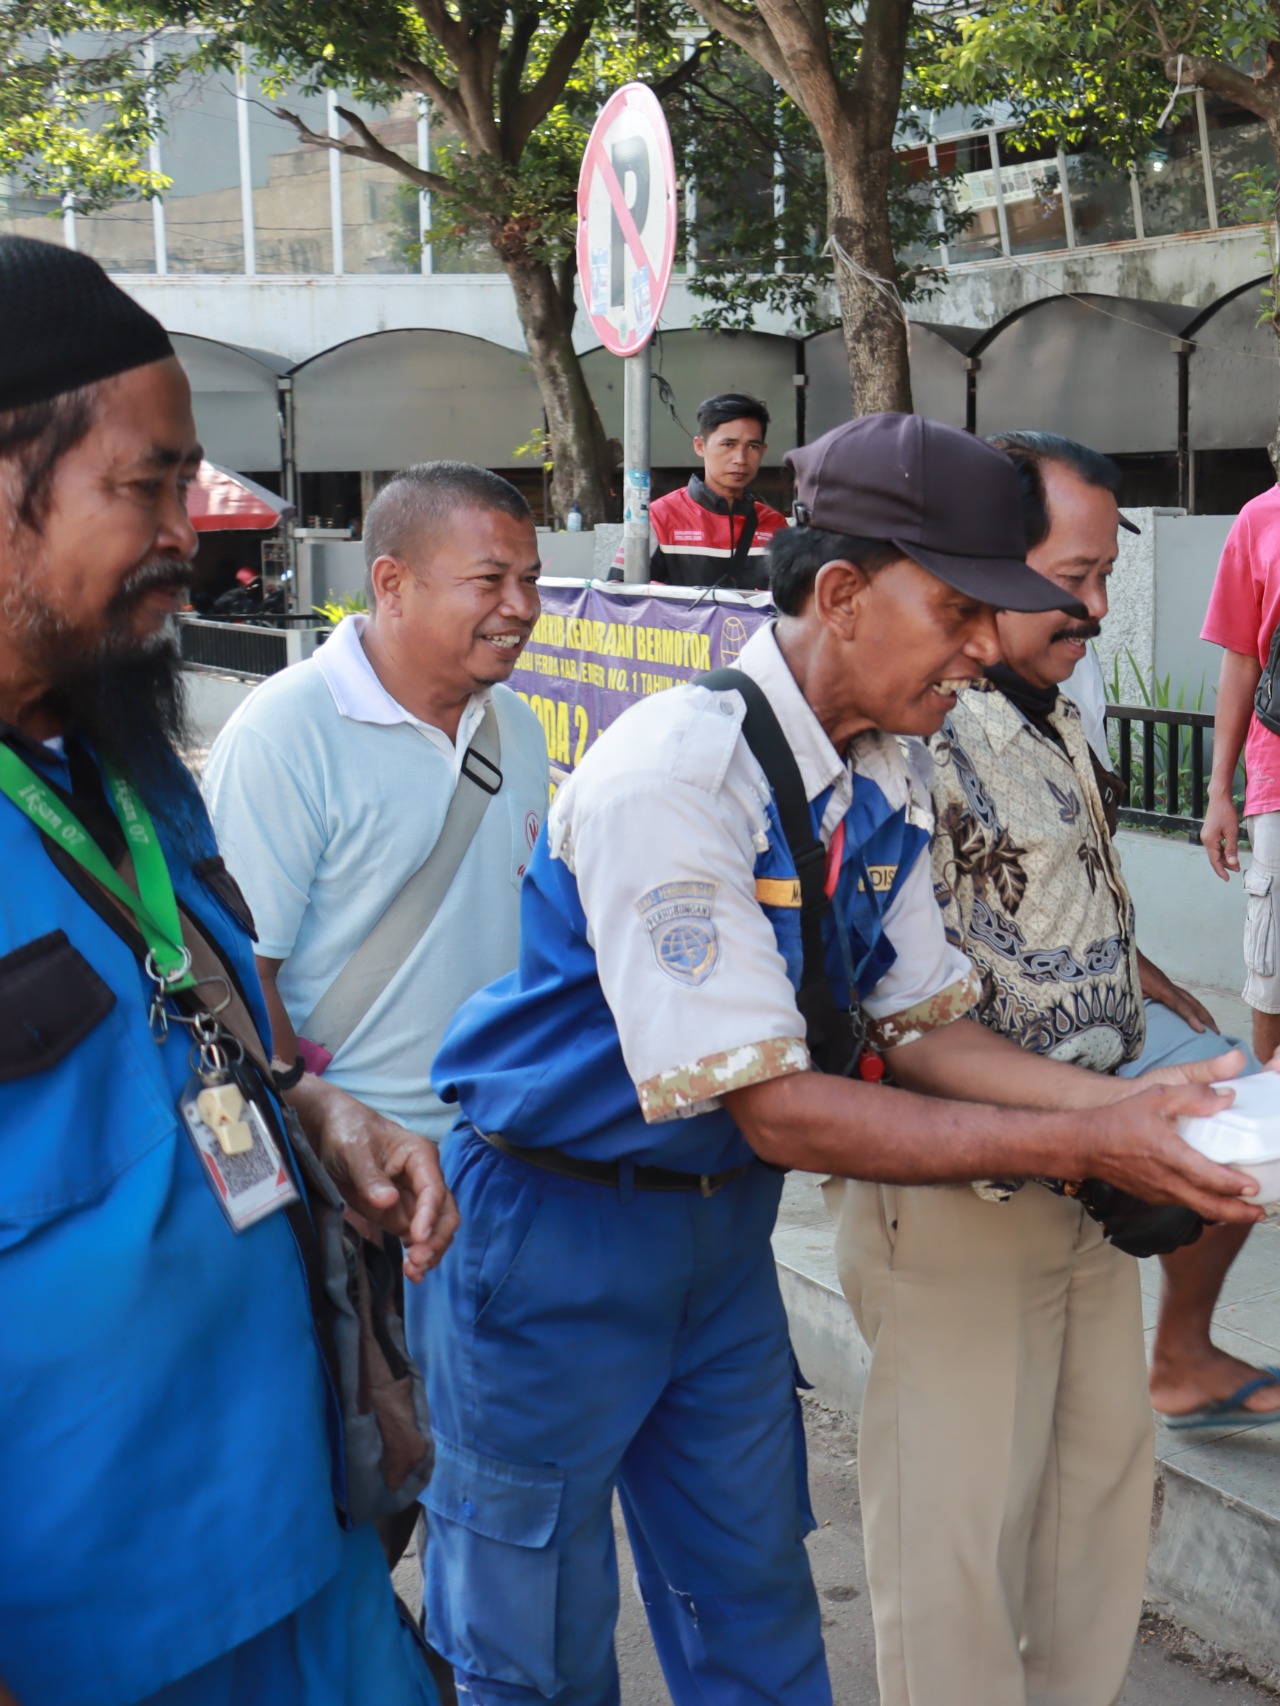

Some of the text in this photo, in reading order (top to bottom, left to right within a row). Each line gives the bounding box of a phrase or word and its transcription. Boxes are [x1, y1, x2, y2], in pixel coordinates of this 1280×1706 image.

[611, 135, 650, 308] P
[637, 626, 711, 671] BERMOTOR
[607, 667, 629, 692] NO.
[632, 671, 638, 693] 1
[640, 672, 673, 695] TAHUN
[574, 704, 589, 768] 2
[61, 824, 86, 845] 07
[128, 824, 149, 844] 07
[868, 869, 896, 887] DIS
